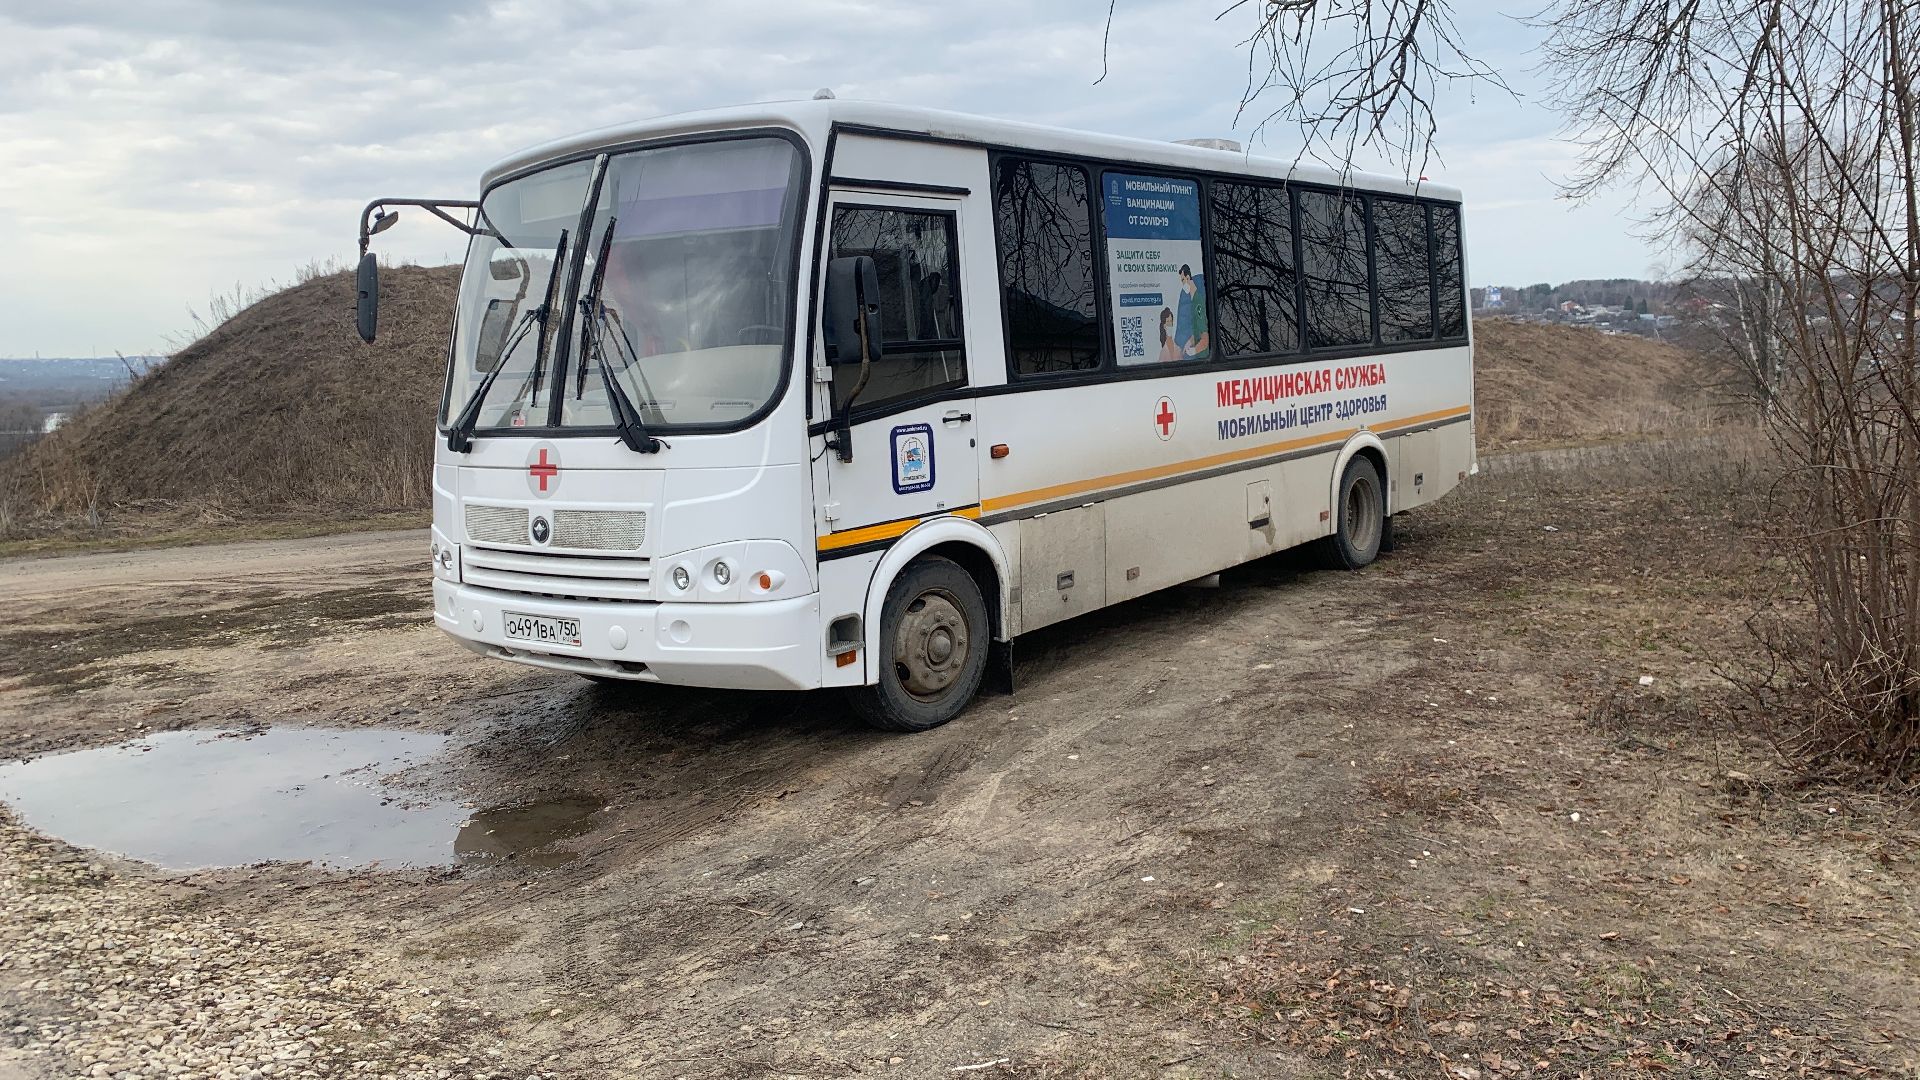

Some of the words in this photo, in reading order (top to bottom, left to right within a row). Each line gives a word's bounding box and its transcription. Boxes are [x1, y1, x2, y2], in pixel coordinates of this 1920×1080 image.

[1125, 180, 1170, 194] МОБИЛЬНЫЙ
[1171, 184, 1193, 196] ПУНКТ
[1126, 198, 1175, 210] ВАКЦИНАЦИИ
[1128, 215, 1138, 225] ОТ
[1140, 216, 1169, 227] COVID-19
[1116, 250, 1144, 260] ЗАЩИТИ
[1145, 251, 1161, 260] СЕБЯ
[1117, 264, 1122, 273] И
[1123, 263, 1146, 273] СВОИХ
[1147, 263, 1178, 273] БЛИЗКИХ!
[1216, 369, 1332, 409] МЕДИЦИНСКАЯ
[1335, 363, 1386, 391] СЛУЖБА
[1218, 403, 1298, 441] МОБИЛЬНЫЙ
[1300, 402, 1333, 428] ЦЕНТР
[1335, 394, 1387, 420] ЗДОРОВЬЯ
[558, 620, 577, 637] 750
